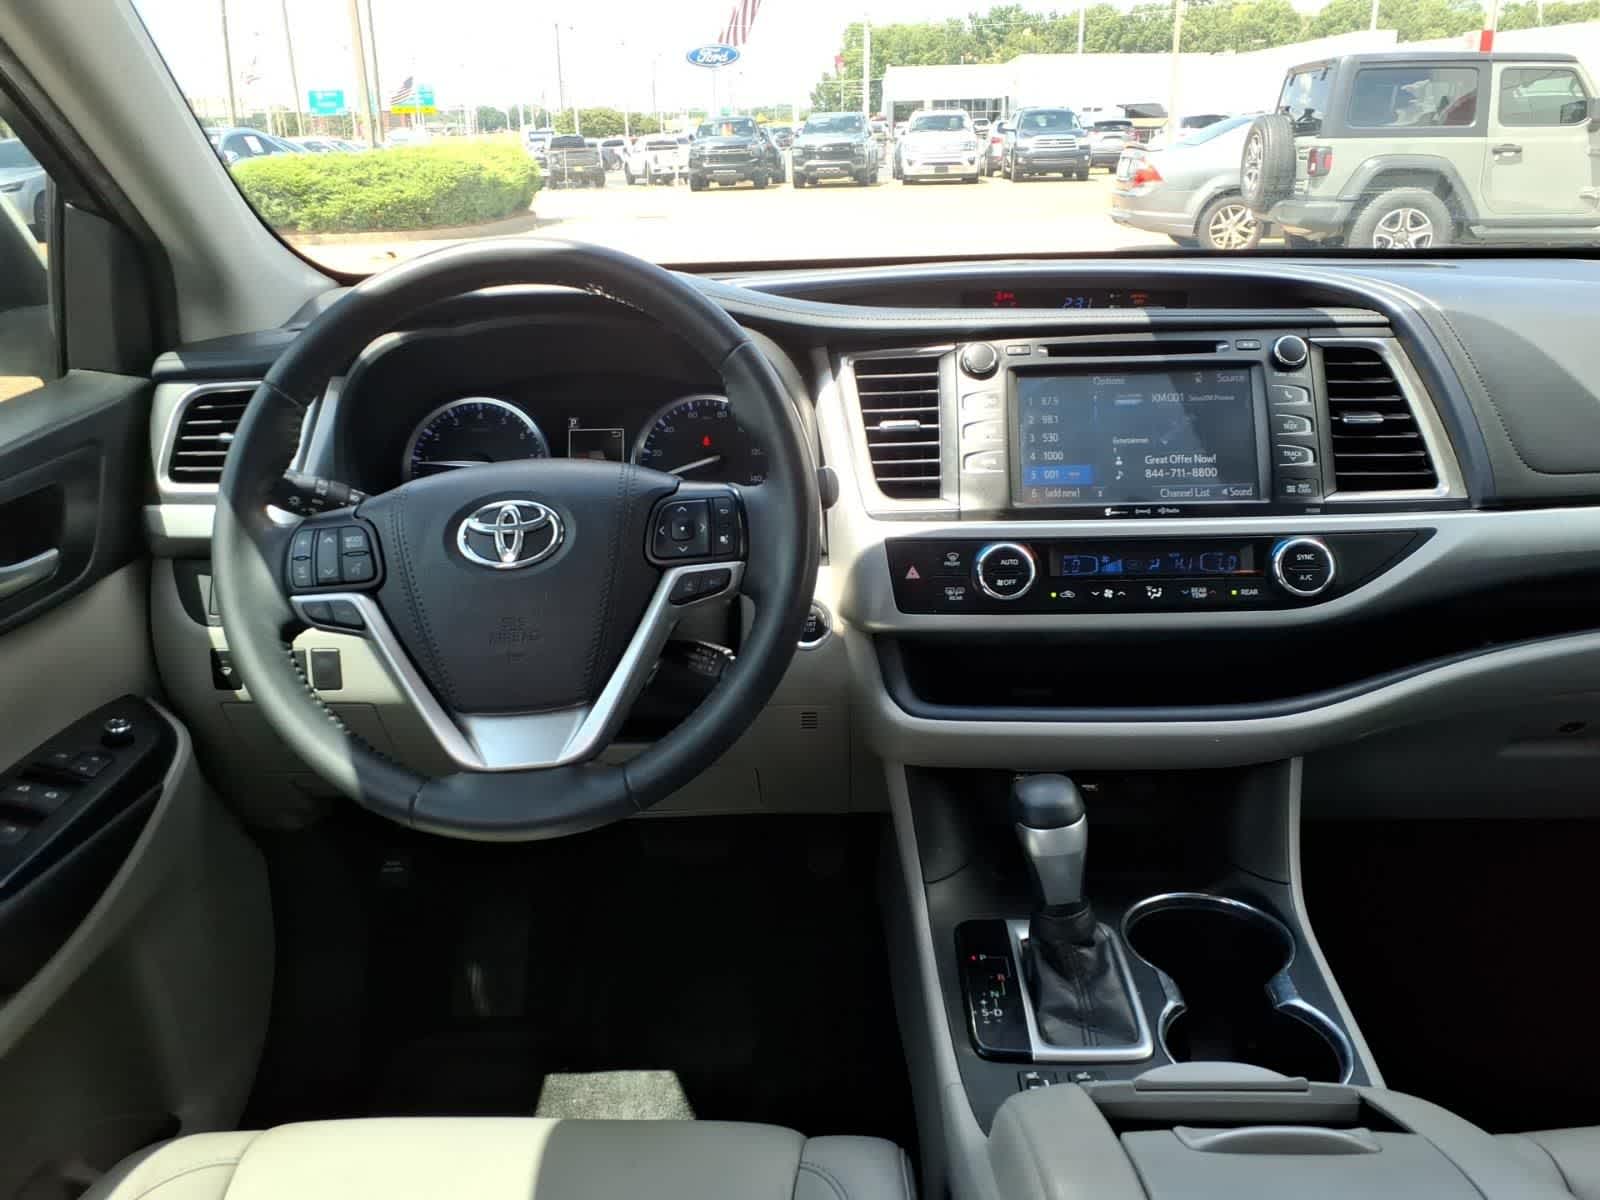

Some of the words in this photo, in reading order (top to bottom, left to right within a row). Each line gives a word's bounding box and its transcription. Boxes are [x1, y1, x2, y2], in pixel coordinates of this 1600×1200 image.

[697, 48, 729, 65] Ford
[1216, 374, 1246, 384] Source
[570, 418, 578, 428] P
[1144, 454, 1169, 465] Great
[1169, 453, 1192, 464] Offer
[1193, 452, 1217, 464] Now!
[1144, 468, 1218, 479] 844-711-8800
[1159, 487, 1193, 498] Channel
[1194, 487, 1210, 497] List
[1228, 487, 1253, 497] Sound
[1296, 553, 1315, 562] SYNC
[1000, 559, 1019, 567] AUTO
[1003, 578, 1017, 587] OFF
[1299, 574, 1313, 582] A/C
[1240, 588, 1258, 596] REAR
